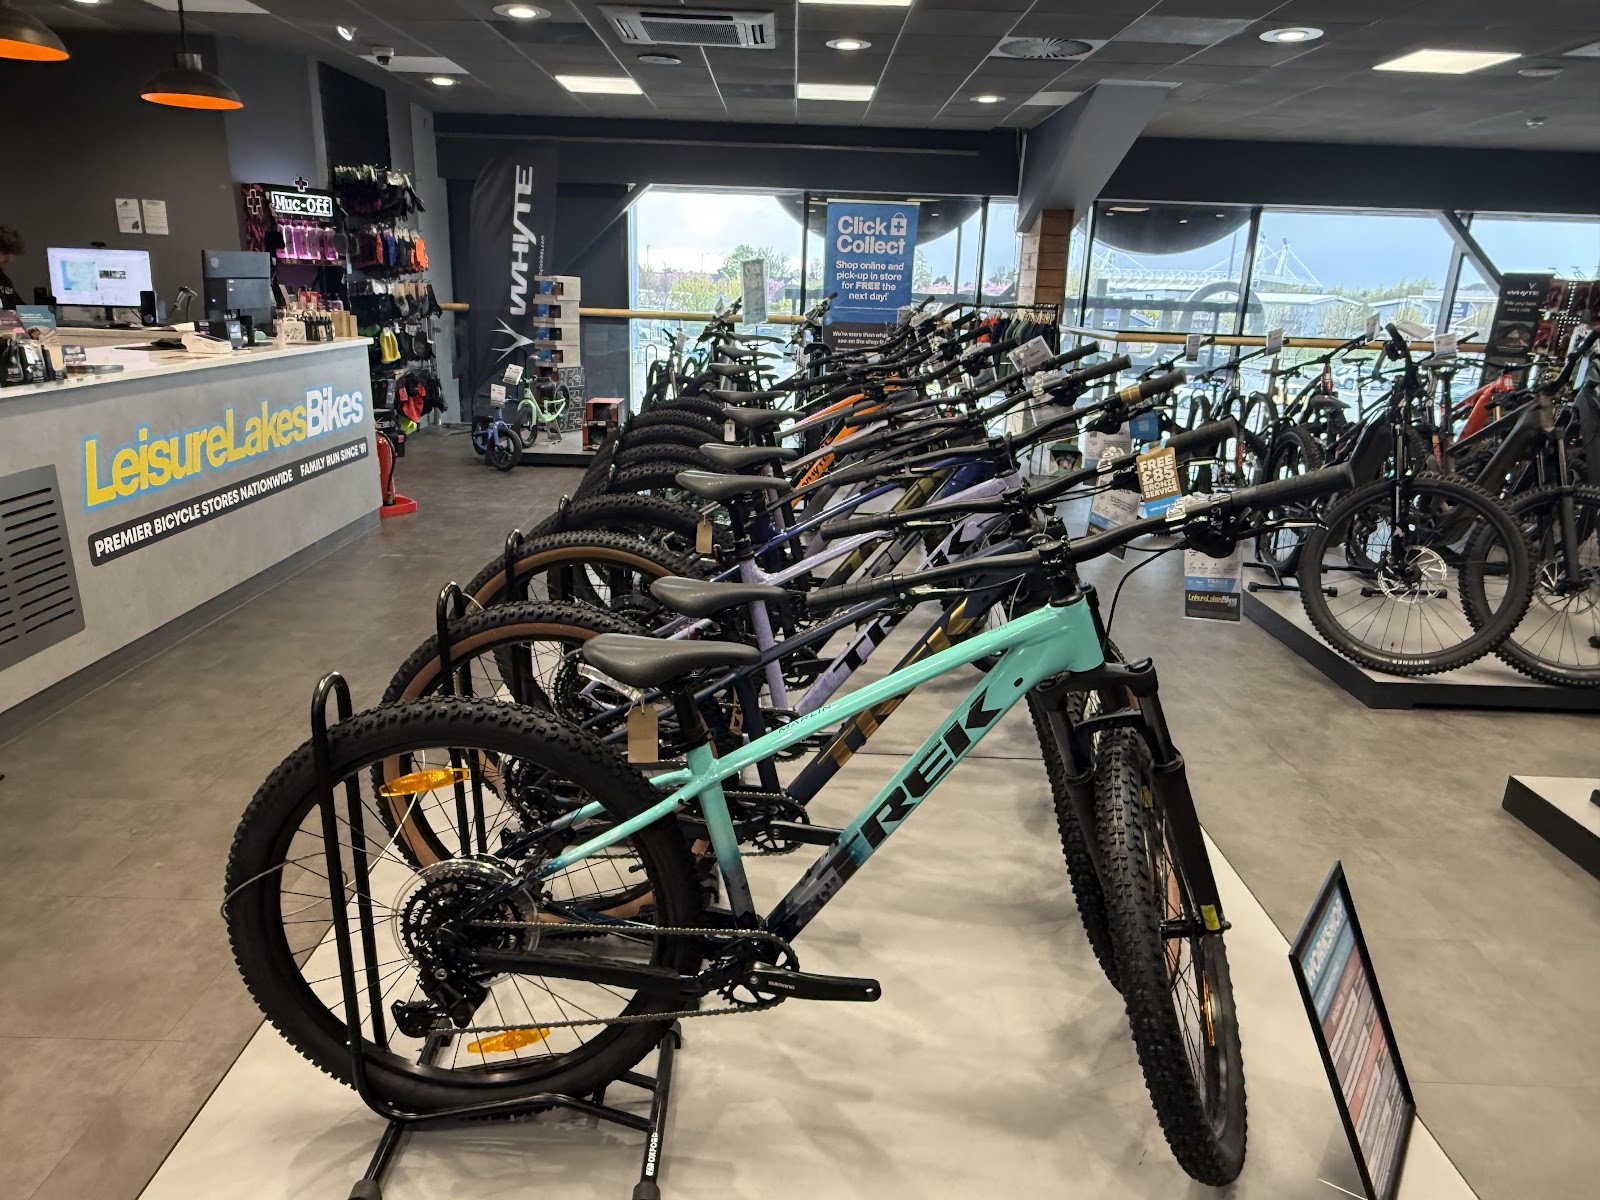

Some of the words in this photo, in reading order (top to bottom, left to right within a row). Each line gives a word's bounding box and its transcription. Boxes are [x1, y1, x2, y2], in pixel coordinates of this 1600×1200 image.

[275, 195, 330, 214] Muc-Off
[837, 215, 887, 235] Click
[509, 164, 537, 316] WHYTE
[836, 234, 906, 255] Collect
[835, 260, 858, 271] Shop
[859, 261, 886, 271] online
[887, 262, 904, 271] and
[836, 271, 869, 281] pick-up
[870, 271, 878, 280] in
[879, 273, 902, 281] store
[841, 281, 854, 290] for
[855, 281, 881, 291] FREE
[881, 282, 896, 291] the
[848, 292, 868, 301] next
[85, 386, 364, 507] LeisureLakesBikes
[1139, 453, 1174, 473] FREE
[1142, 465, 1175, 486] £85
[1143, 477, 1177, 493] BRONZE
[94, 521, 153, 558] PREMIER
[154, 503, 201, 535] BICYCLE
[201, 488, 240, 516] STORES
[240, 469, 294, 501] NATIONWIDE
[300, 456, 325, 477] FAMILY
[326, 451, 340, 468] RUN
[340, 445, 358, 462] SINCE
[1145, 484, 1178, 499] SERVICE
[815, 685, 1003, 884] TREK
[1303, 897, 1343, 987] WORKSHOP
[647, 1132, 659, 1163] OXFORD
